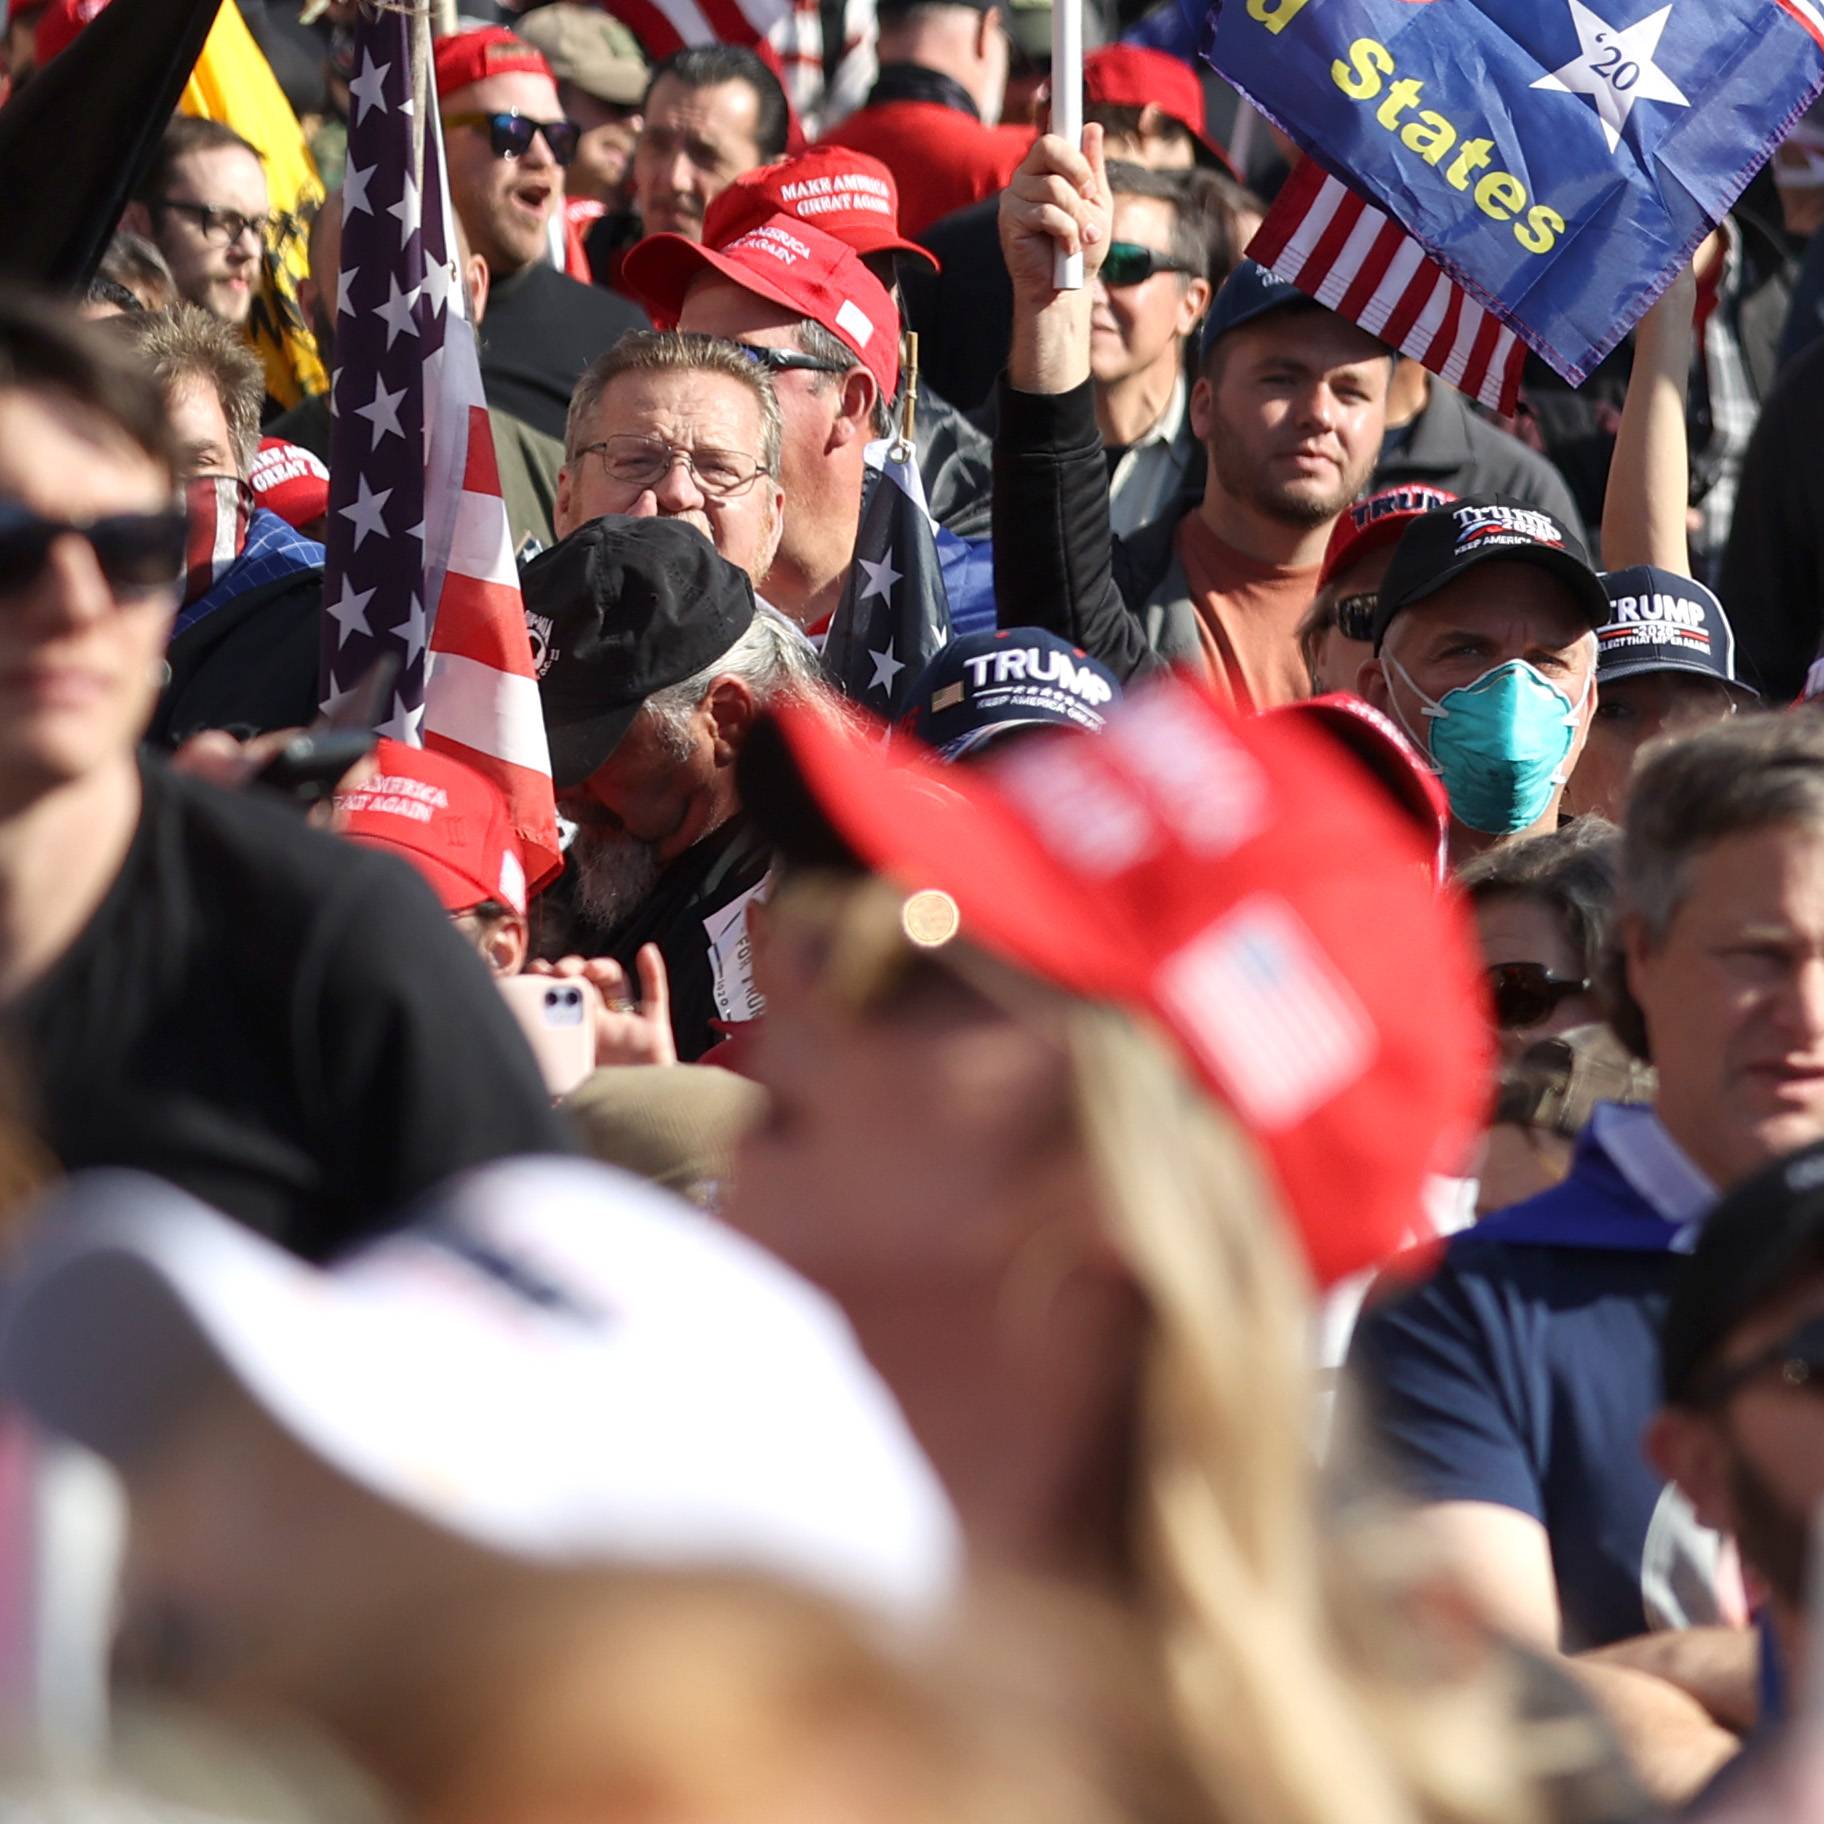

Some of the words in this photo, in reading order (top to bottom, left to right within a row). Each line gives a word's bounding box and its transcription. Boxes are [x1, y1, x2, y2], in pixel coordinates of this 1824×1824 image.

[1329, 35, 1567, 256] States
[781, 177, 834, 202] MAKE
[1610, 593, 1705, 627] RUMP
[963, 646, 1113, 707] TRUMP
[1010, 695, 1066, 715] AMERICA
[369, 796, 435, 824] AGAIN
